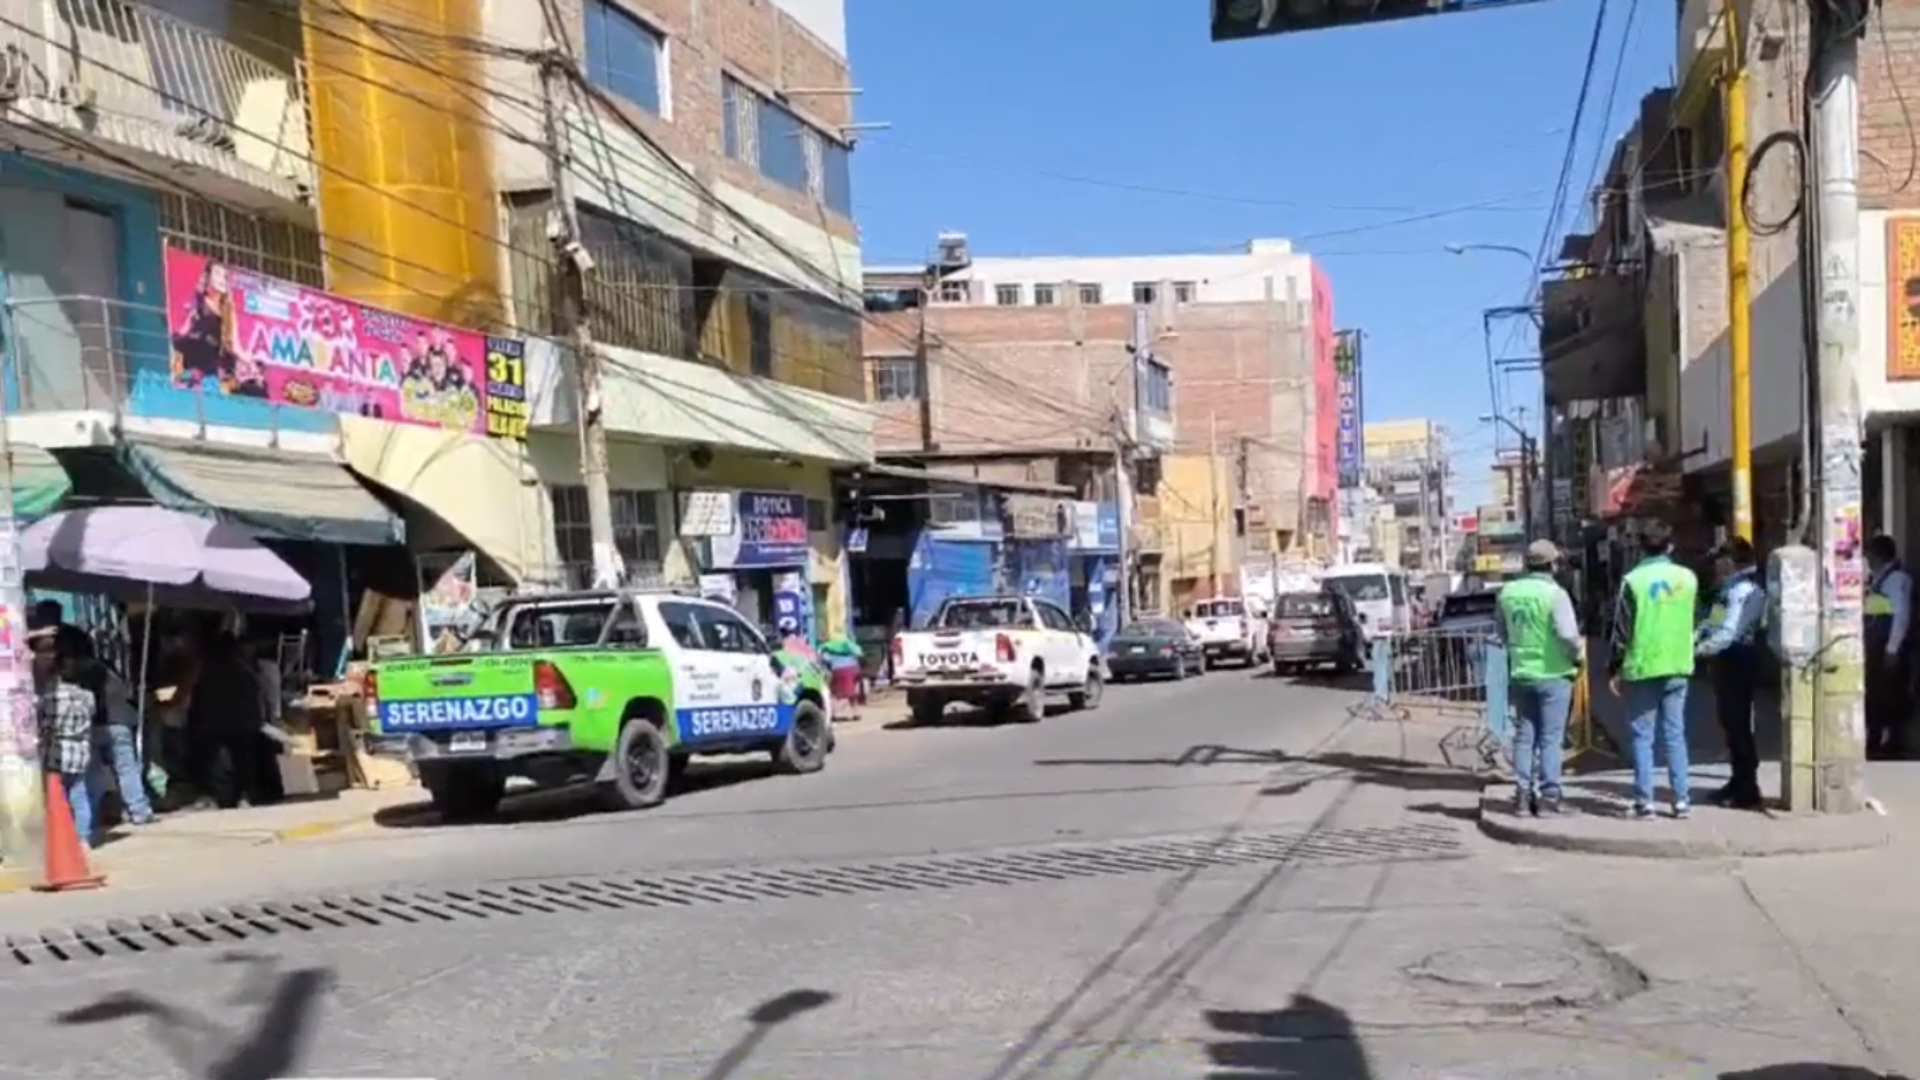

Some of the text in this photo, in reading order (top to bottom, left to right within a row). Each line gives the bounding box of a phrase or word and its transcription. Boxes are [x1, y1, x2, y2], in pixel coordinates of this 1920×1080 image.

[487, 352, 524, 387] 31
[1339, 377, 1354, 457] HOTEL
[918, 653, 979, 666] TOYOTA
[387, 696, 529, 725] SERENAZGO
[691, 706, 778, 735] SERENAZGO
